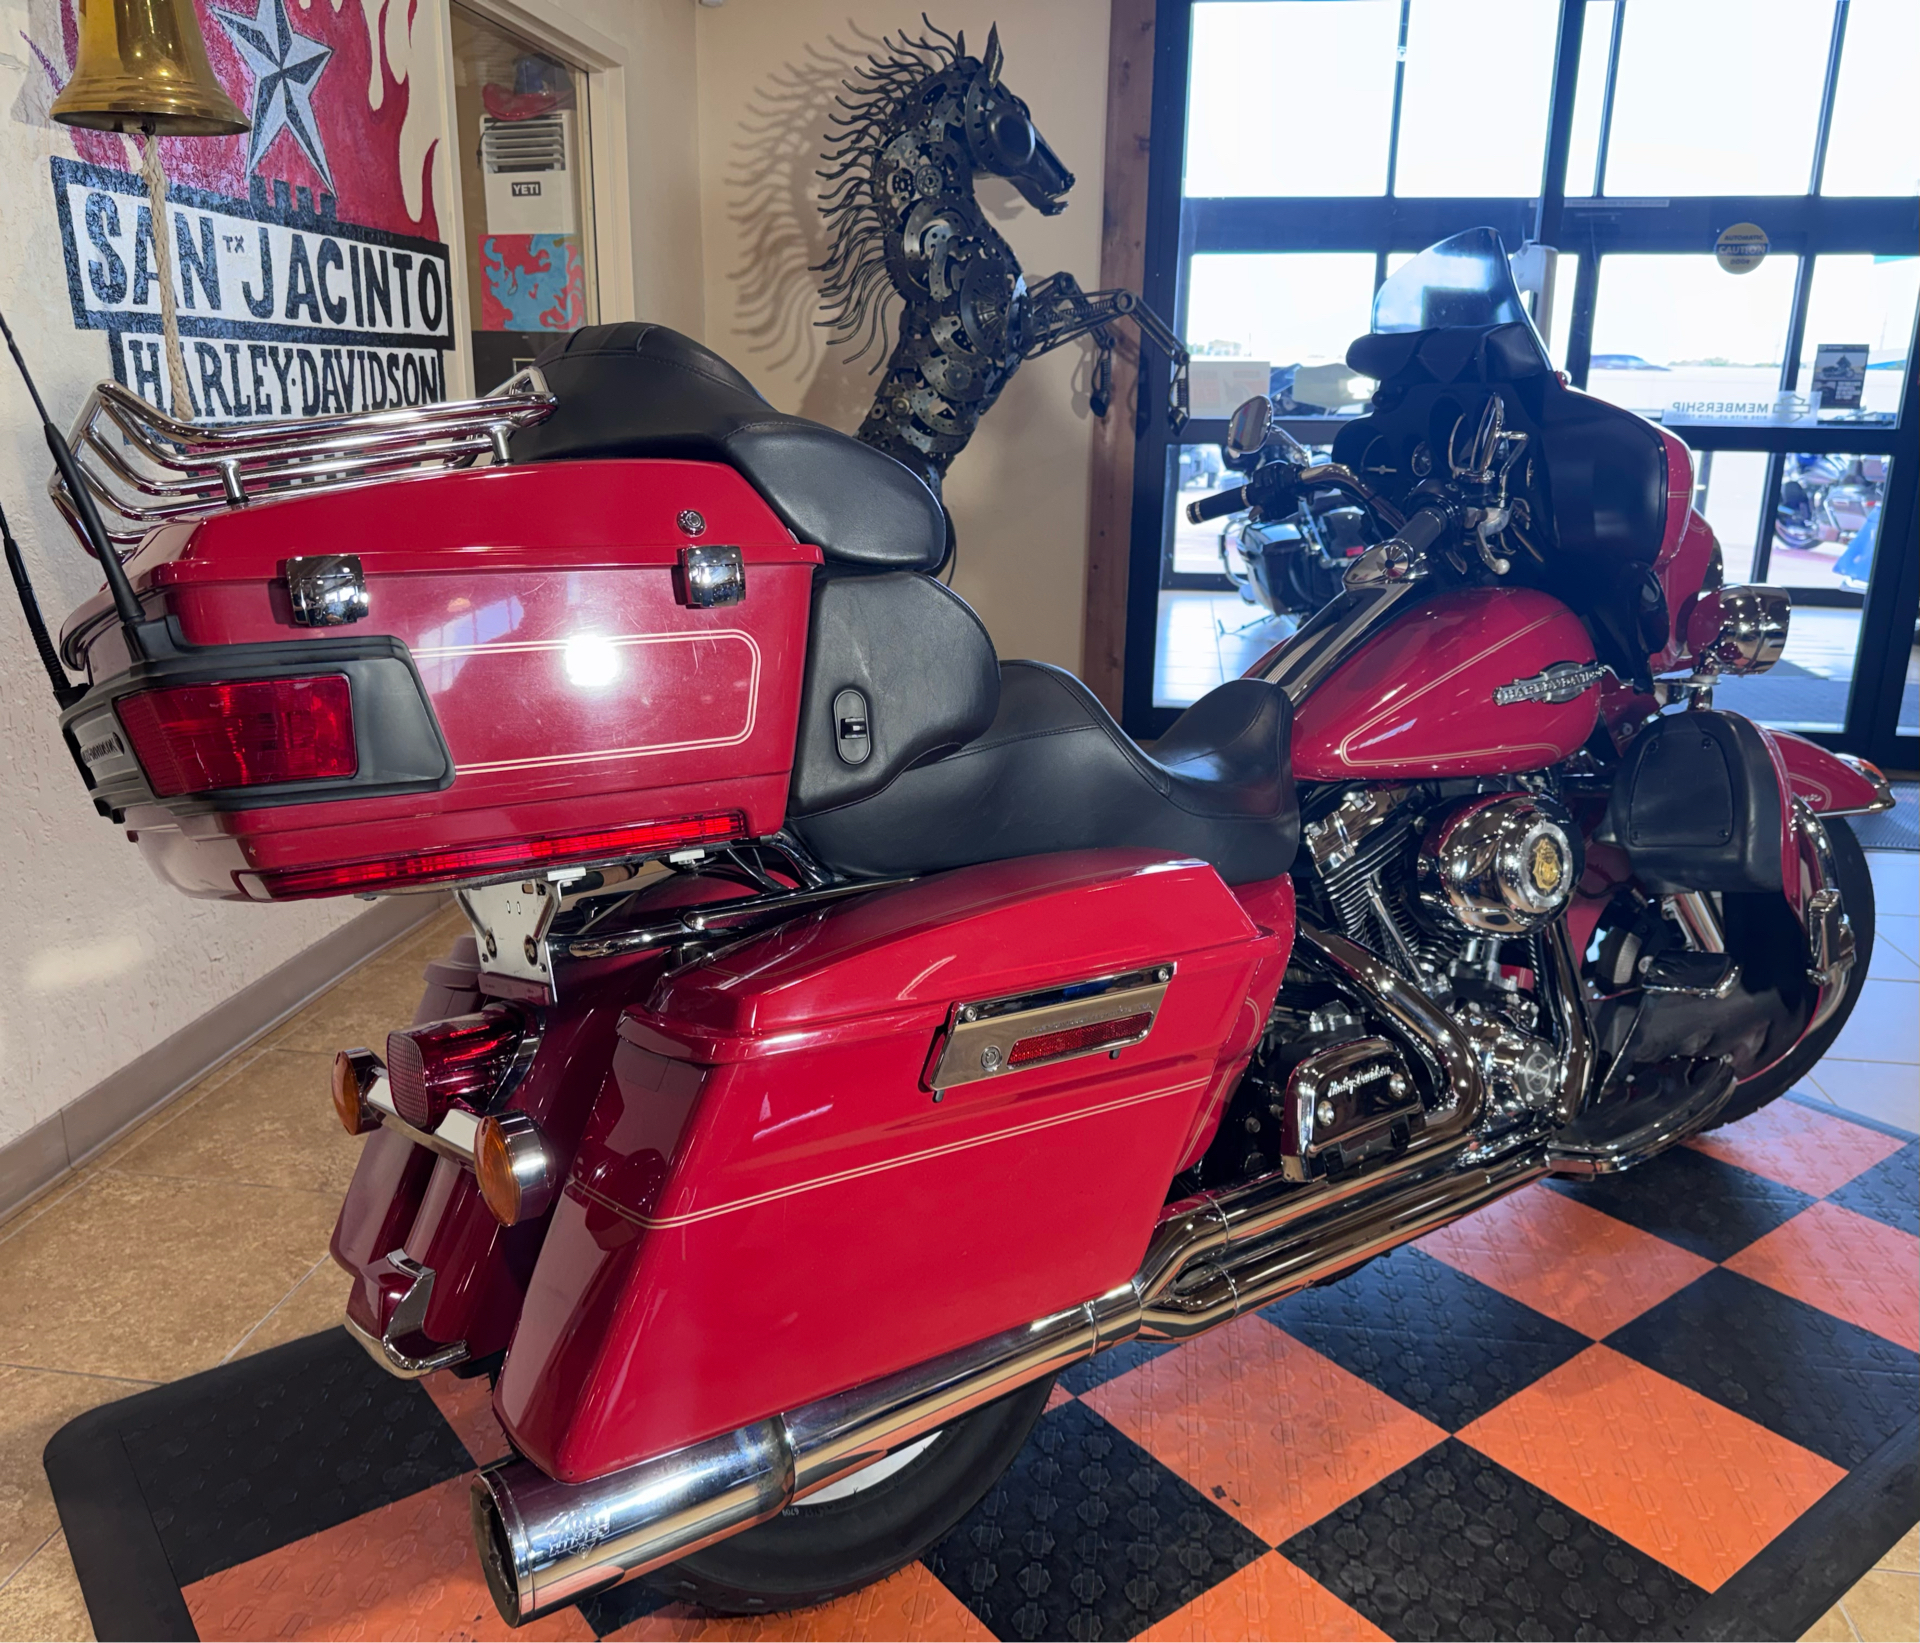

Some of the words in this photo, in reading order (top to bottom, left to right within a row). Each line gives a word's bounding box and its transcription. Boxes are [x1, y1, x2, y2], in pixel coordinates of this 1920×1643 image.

[512, 183, 539, 195] YETI
[1718, 245, 1767, 255] CAUTION
[85, 191, 222, 311] SAN
[222, 235, 246, 254] TX
[242, 226, 443, 332] JACINTO
